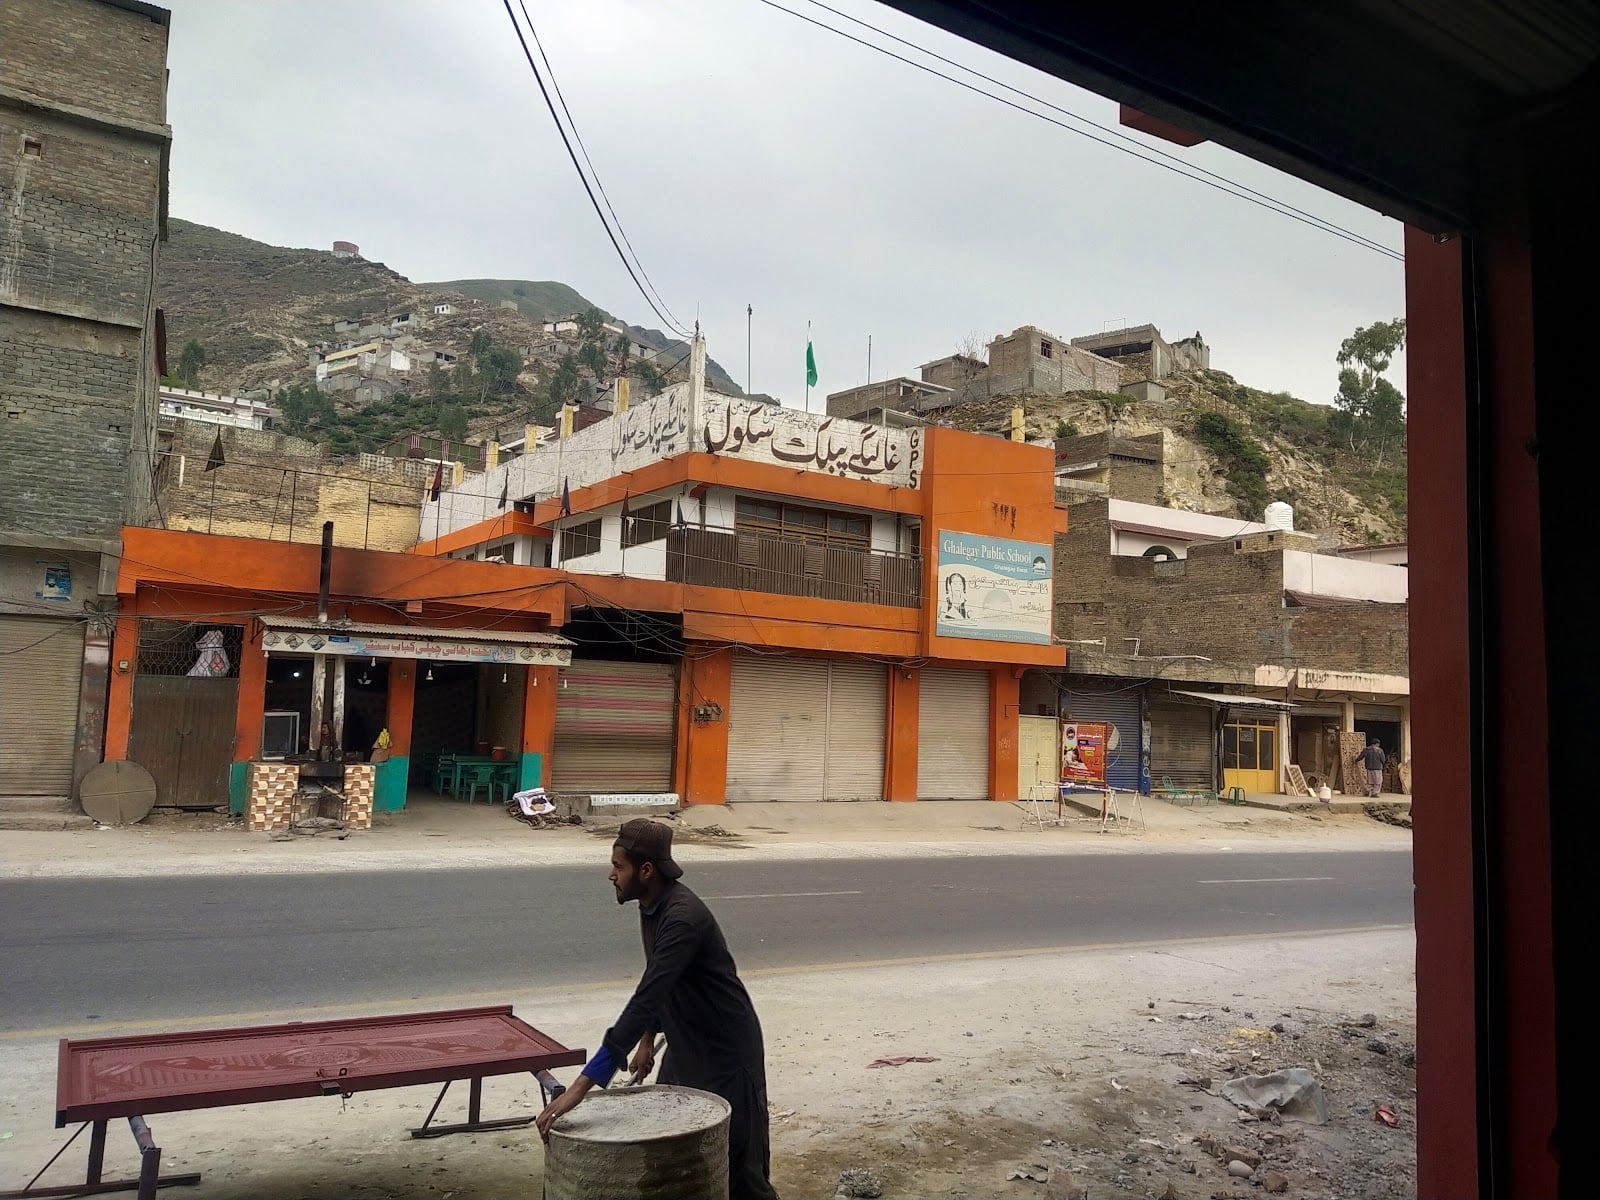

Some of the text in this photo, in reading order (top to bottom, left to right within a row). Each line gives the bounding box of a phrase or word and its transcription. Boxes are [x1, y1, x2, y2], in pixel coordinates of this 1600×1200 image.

[704, 400, 775, 454] سکول
[771, 417, 848, 478] پبلک
[944, 539, 1032, 564] Ghalegay Public School
